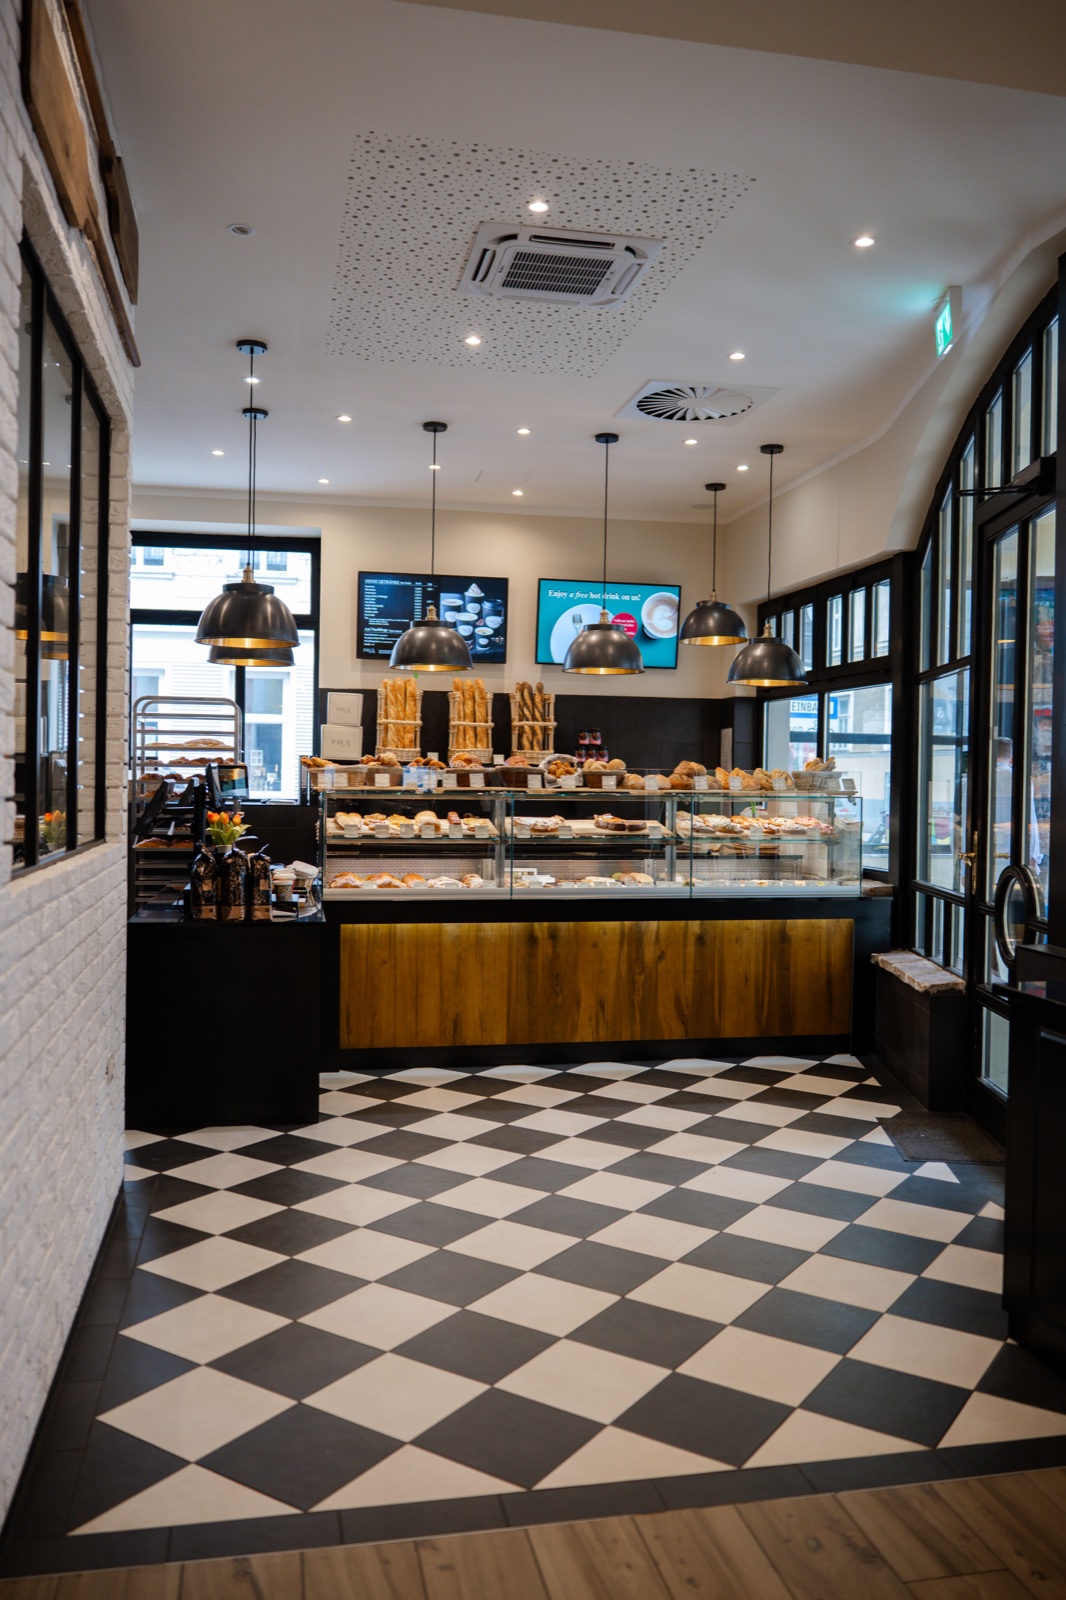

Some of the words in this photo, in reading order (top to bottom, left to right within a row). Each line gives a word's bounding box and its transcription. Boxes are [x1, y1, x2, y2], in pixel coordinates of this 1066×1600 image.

[548, 590, 567, 598] Enjoy
[574, 591, 588, 599] free
[792, 702, 817, 711] EINBA
